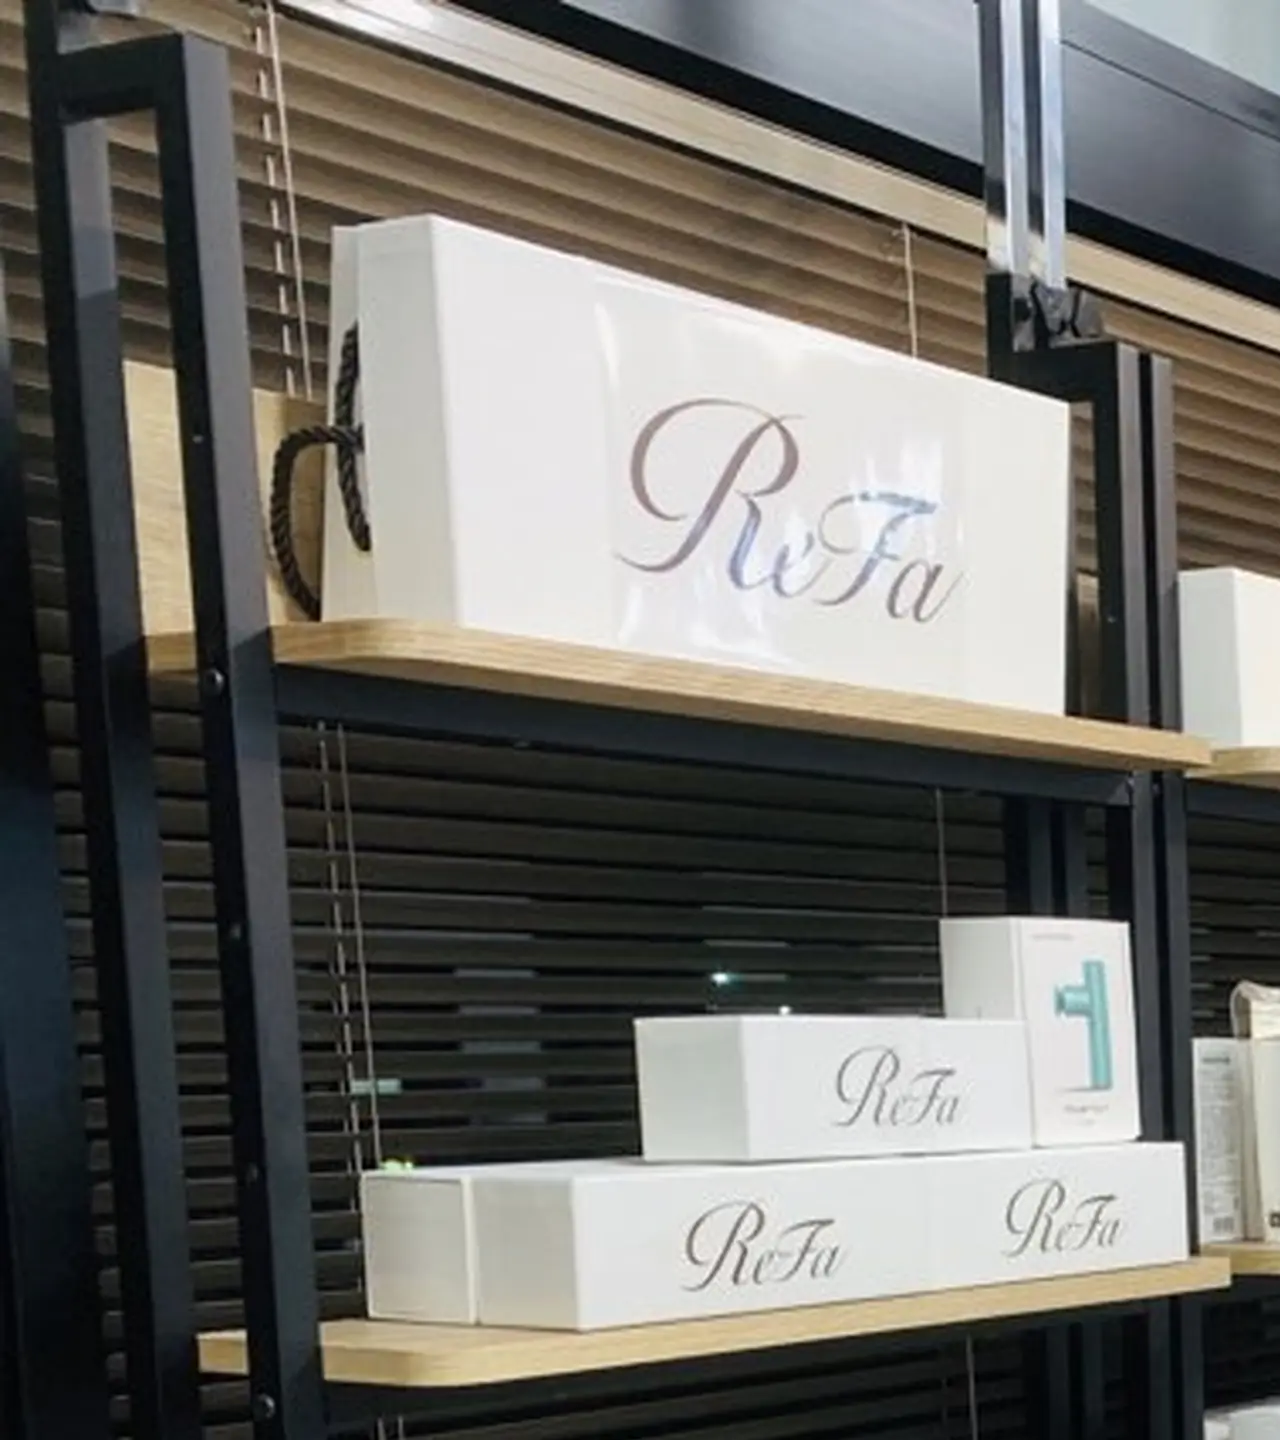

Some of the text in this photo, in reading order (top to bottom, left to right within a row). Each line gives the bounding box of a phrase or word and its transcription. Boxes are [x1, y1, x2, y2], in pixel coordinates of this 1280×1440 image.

[614, 397, 972, 625] ReFa
[834, 1045, 966, 1128] ReFa
[680, 1201, 847, 1294] ReFa
[1002, 1177, 1132, 1259] ReFa
